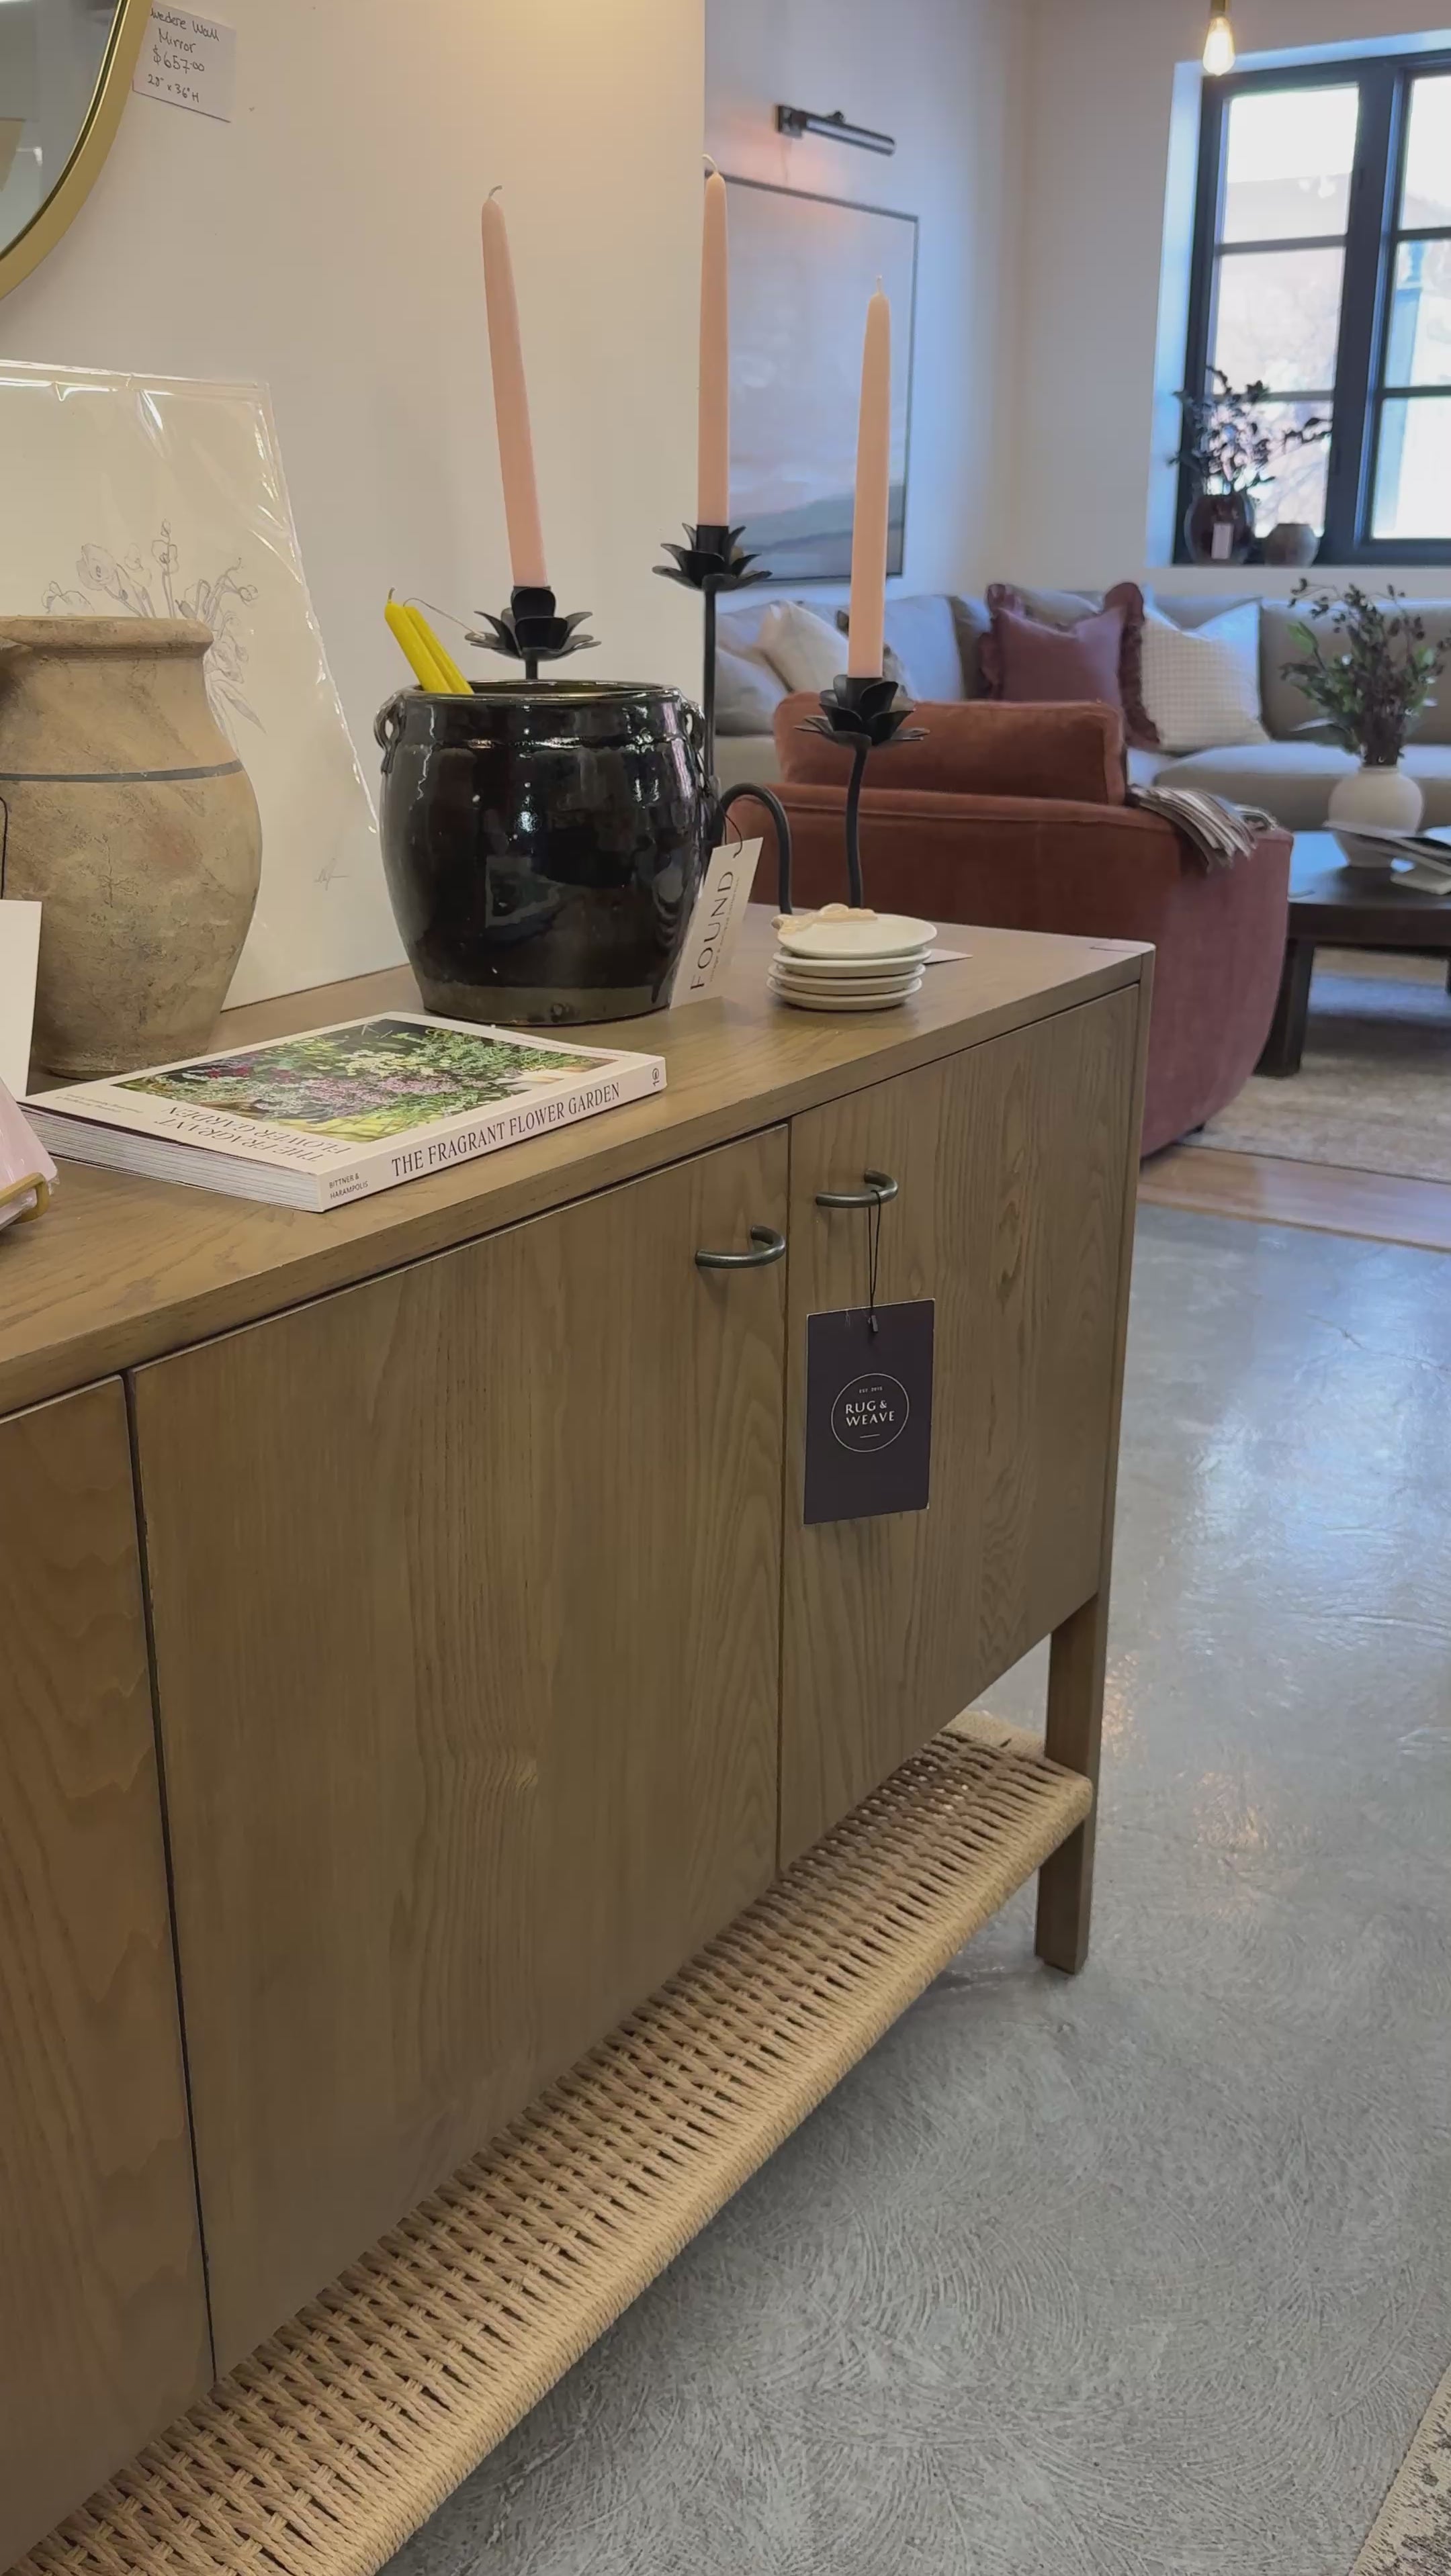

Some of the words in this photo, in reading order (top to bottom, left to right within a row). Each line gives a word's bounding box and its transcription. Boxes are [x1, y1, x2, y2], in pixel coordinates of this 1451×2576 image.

[159, 28, 196, 53] Mirror
[192, 21, 220, 41] Wall
[690, 872, 734, 990] FOUND
[161, 1107, 255, 1132] GARDEN
[392, 1150, 424, 1177] THE
[428, 1121, 505, 1165] FRAGRANT
[509, 1101, 565, 1136] FLOWER
[568, 1083, 620, 1115] GARDEN
[154, 1119, 278, 1150] FRAGRANT
[254, 1130, 351, 1154] FLOWER
[273, 1146, 324, 1162] THE
[328, 1175, 354, 1189] BITTNER
[330, 1181, 369, 1199] HARAMPOLIS
[846, 1401, 876, 1414] RUG
[879, 1400, 887, 1409] &
[846, 1411, 895, 1426] WEAVE
